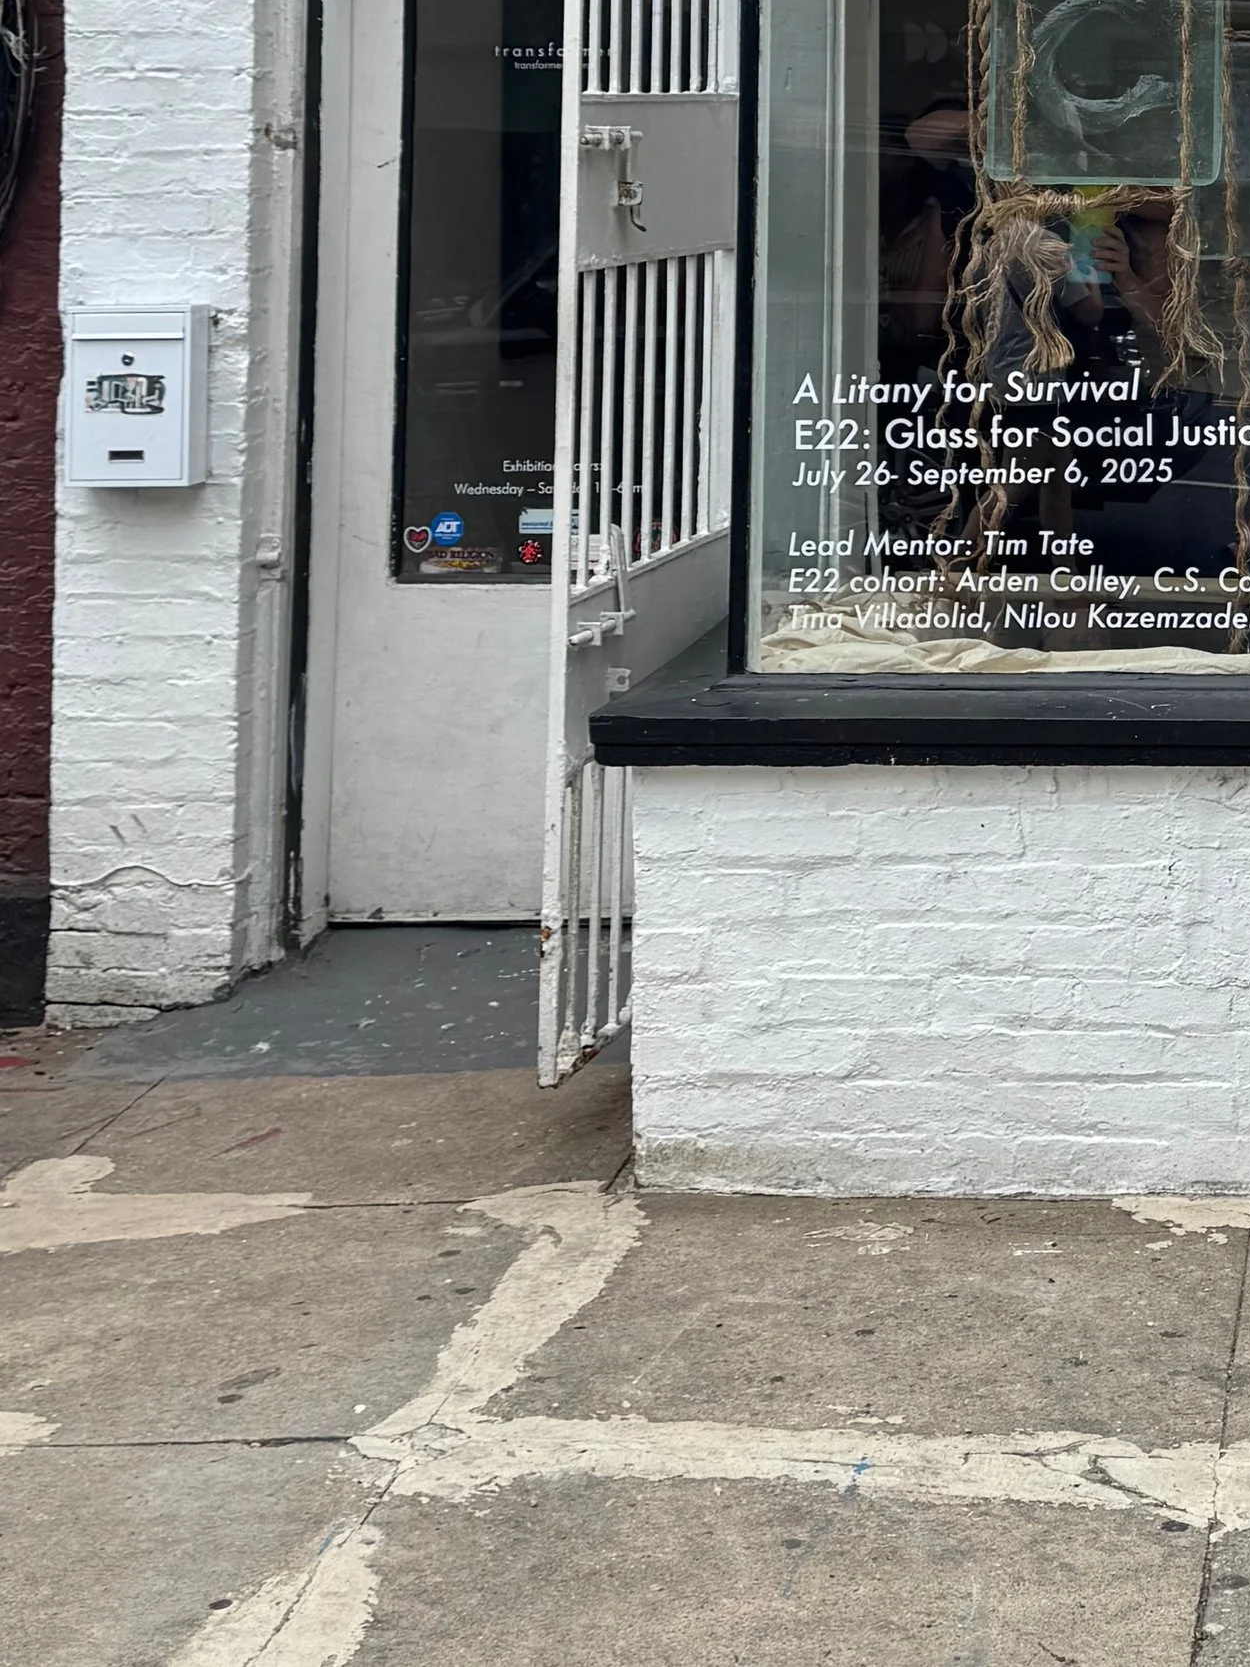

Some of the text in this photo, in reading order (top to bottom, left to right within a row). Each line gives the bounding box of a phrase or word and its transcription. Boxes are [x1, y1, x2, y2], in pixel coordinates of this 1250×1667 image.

[792, 368, 1140, 413] A Litany for Survival
[795, 420, 871, 451] E22:
[885, 418, 978, 450] Glass
[990, 417, 1040, 449] for
[1051, 415, 1154, 448] Social
[454, 483, 524, 497] Wednesday
[791, 457, 1173, 493] July 26- September 6, 2025
[435, 521, 461, 533] ADT
[450, 550, 495, 559] RELIGION
[788, 531, 1095, 558] Lead Mentor: Tim Tate
[788, 569, 841, 593] E22
[849, 568, 946, 593] cohort:
[955, 567, 1039, 593] Arden
[1049, 567, 1142, 598] Colley,
[1154, 567, 1206, 593] C.S.
[788, 604, 844, 630] Tina
[855, 602, 992, 633] Villadolid,
[1004, 602, 1078, 630] Nilou
